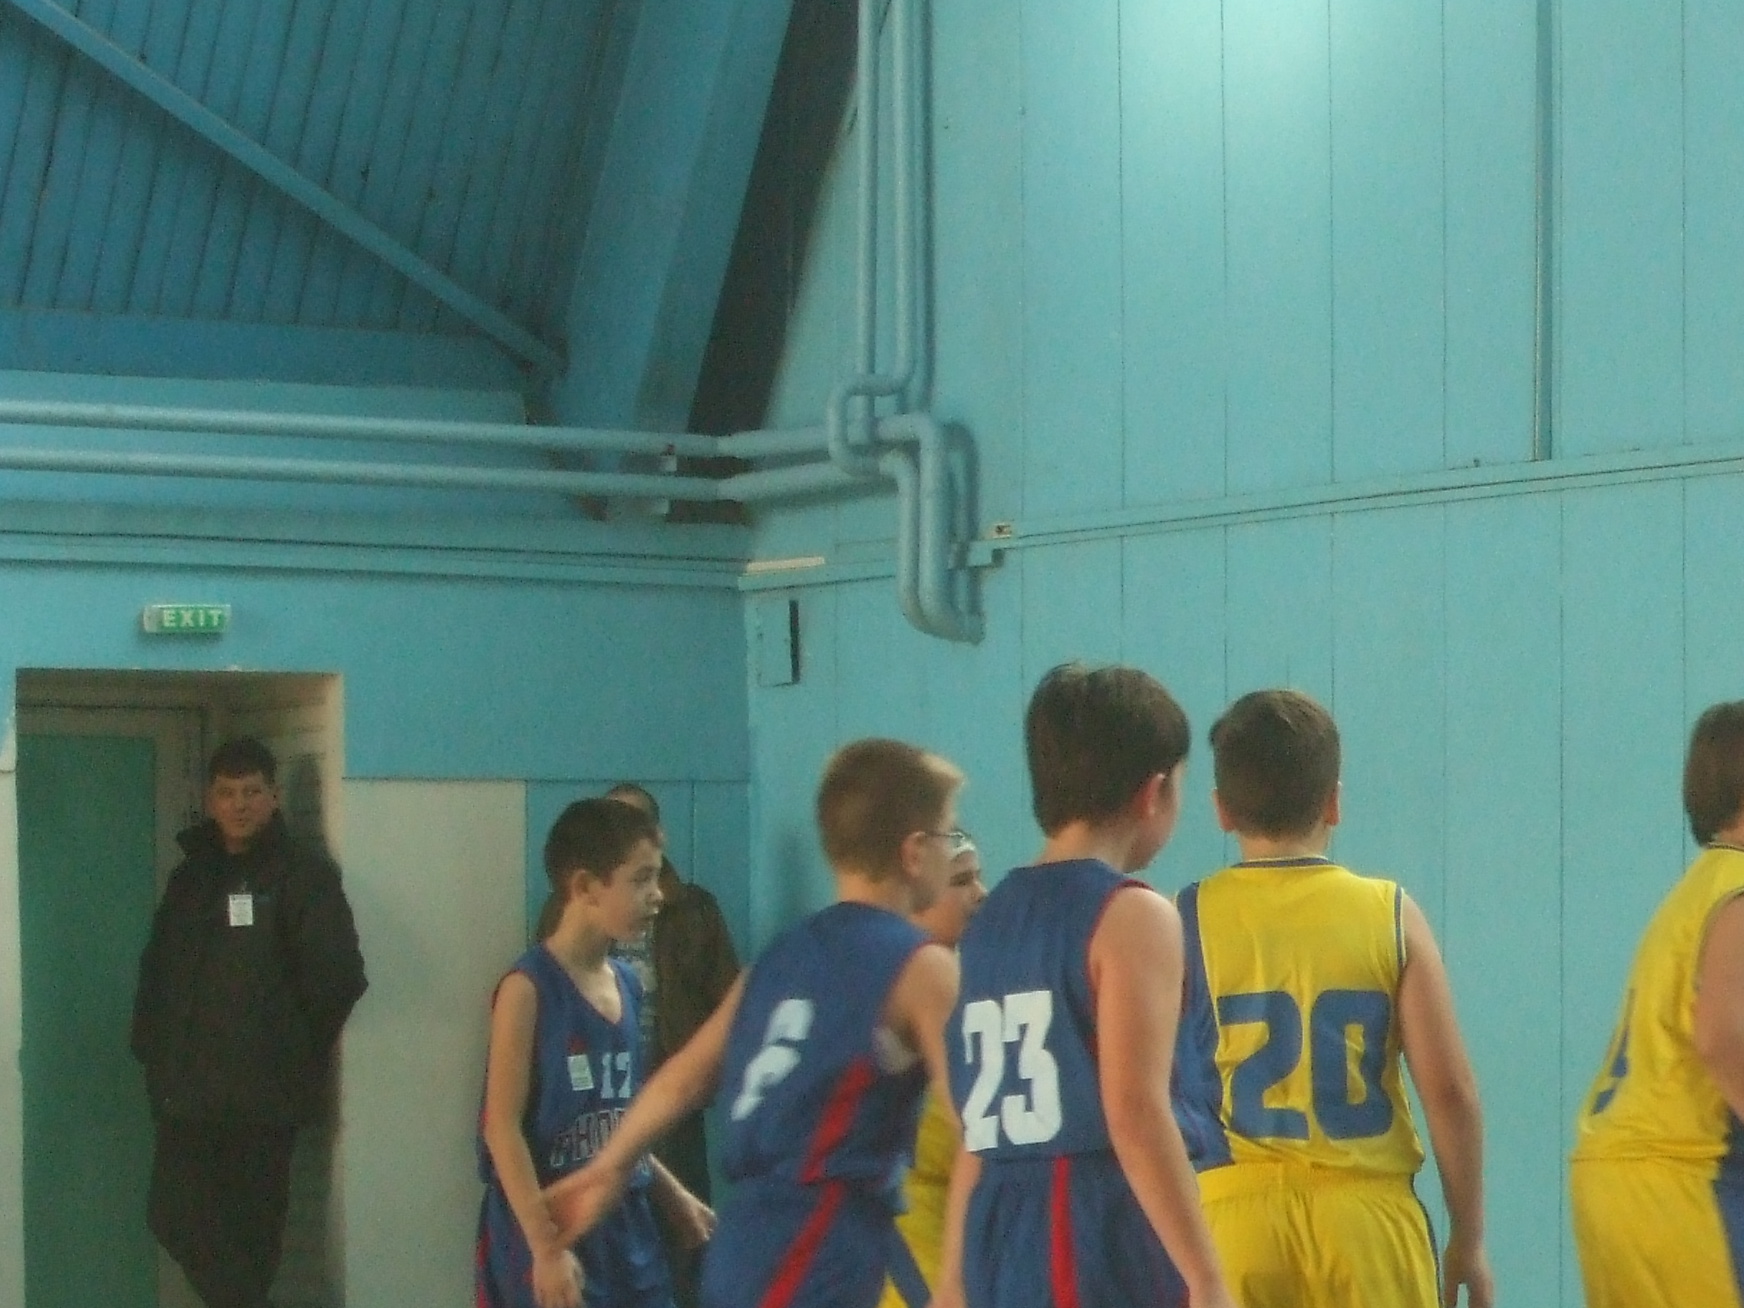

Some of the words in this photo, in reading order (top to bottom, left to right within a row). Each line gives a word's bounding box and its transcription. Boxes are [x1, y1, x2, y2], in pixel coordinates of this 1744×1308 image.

[163, 609, 222, 628] EXIT
[962, 990, 1063, 1152] 23
[1217, 989, 1393, 1140] 20
